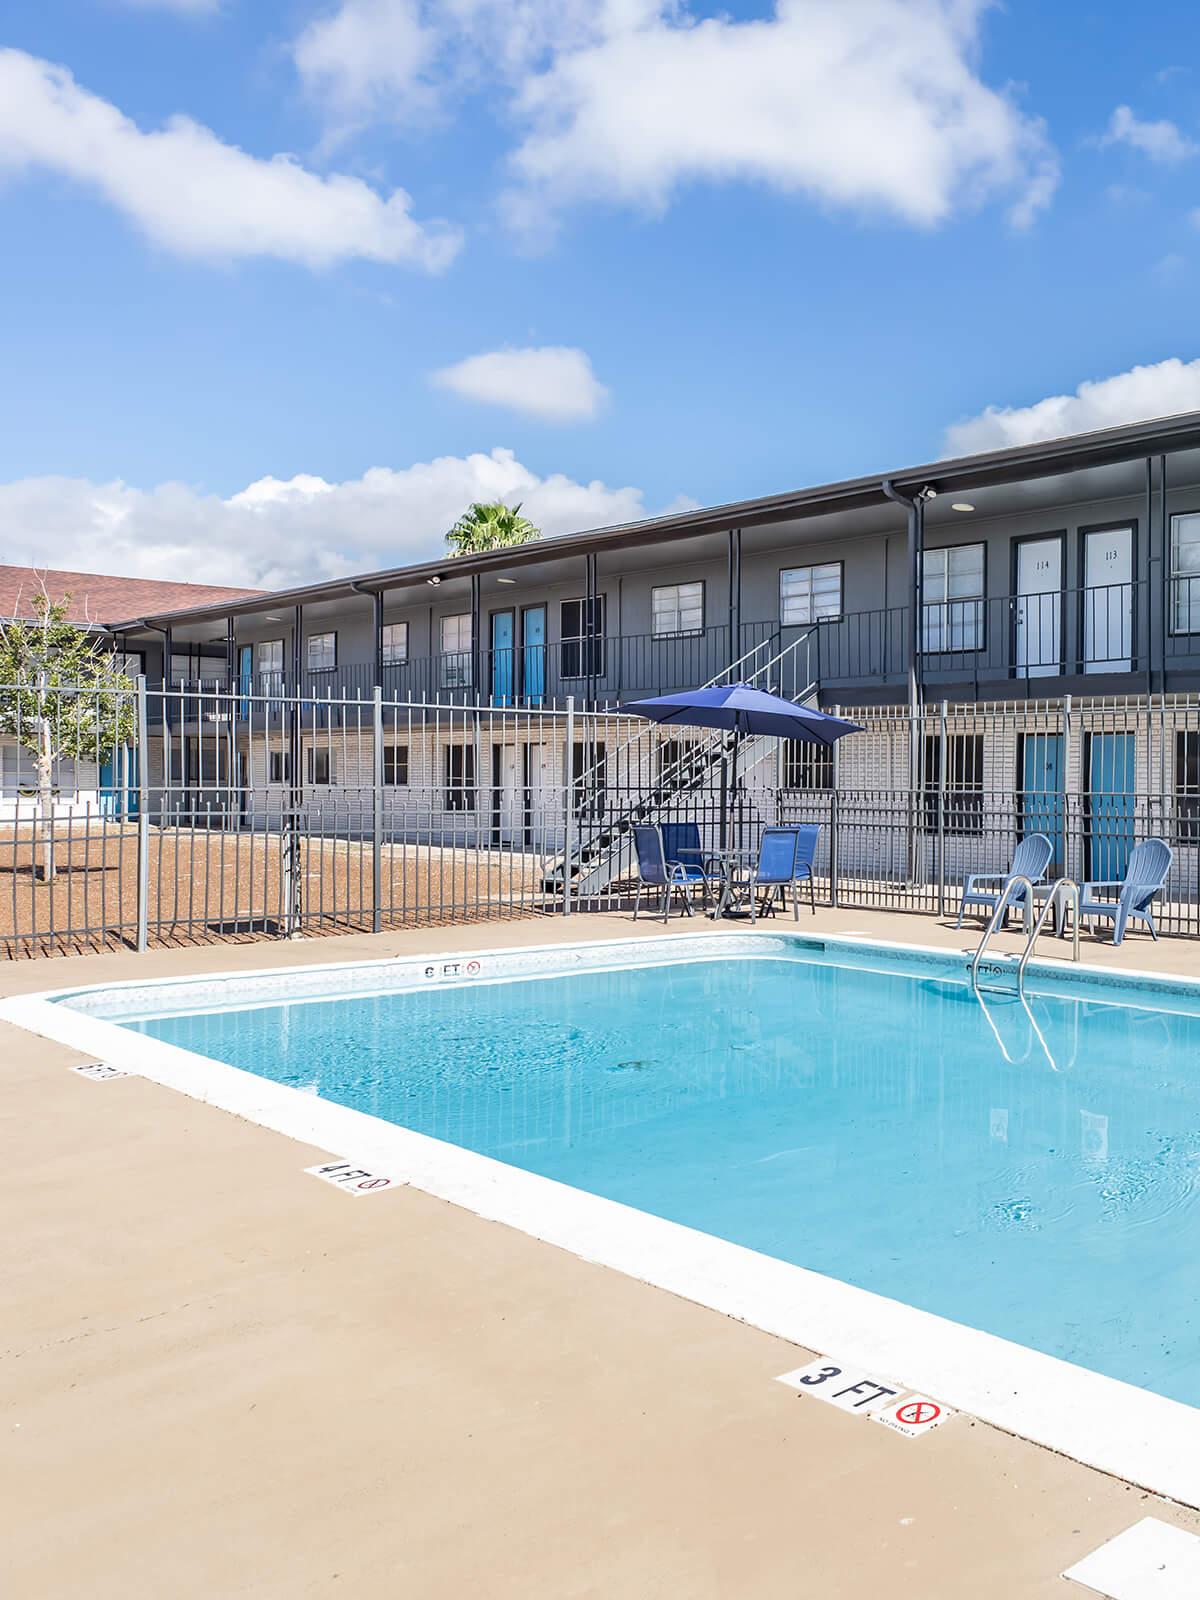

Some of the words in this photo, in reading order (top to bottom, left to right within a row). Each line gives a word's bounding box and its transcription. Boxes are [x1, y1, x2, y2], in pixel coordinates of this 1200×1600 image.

[1105, 550, 1118, 561] 113
[1036, 561, 1049, 570] 114
[443, 964, 461, 976] FT
[319, 1164, 350, 1174] 4
[329, 1170, 373, 1182] FT
[800, 1366, 842, 1386] 3
[832, 1380, 897, 1407] FT
